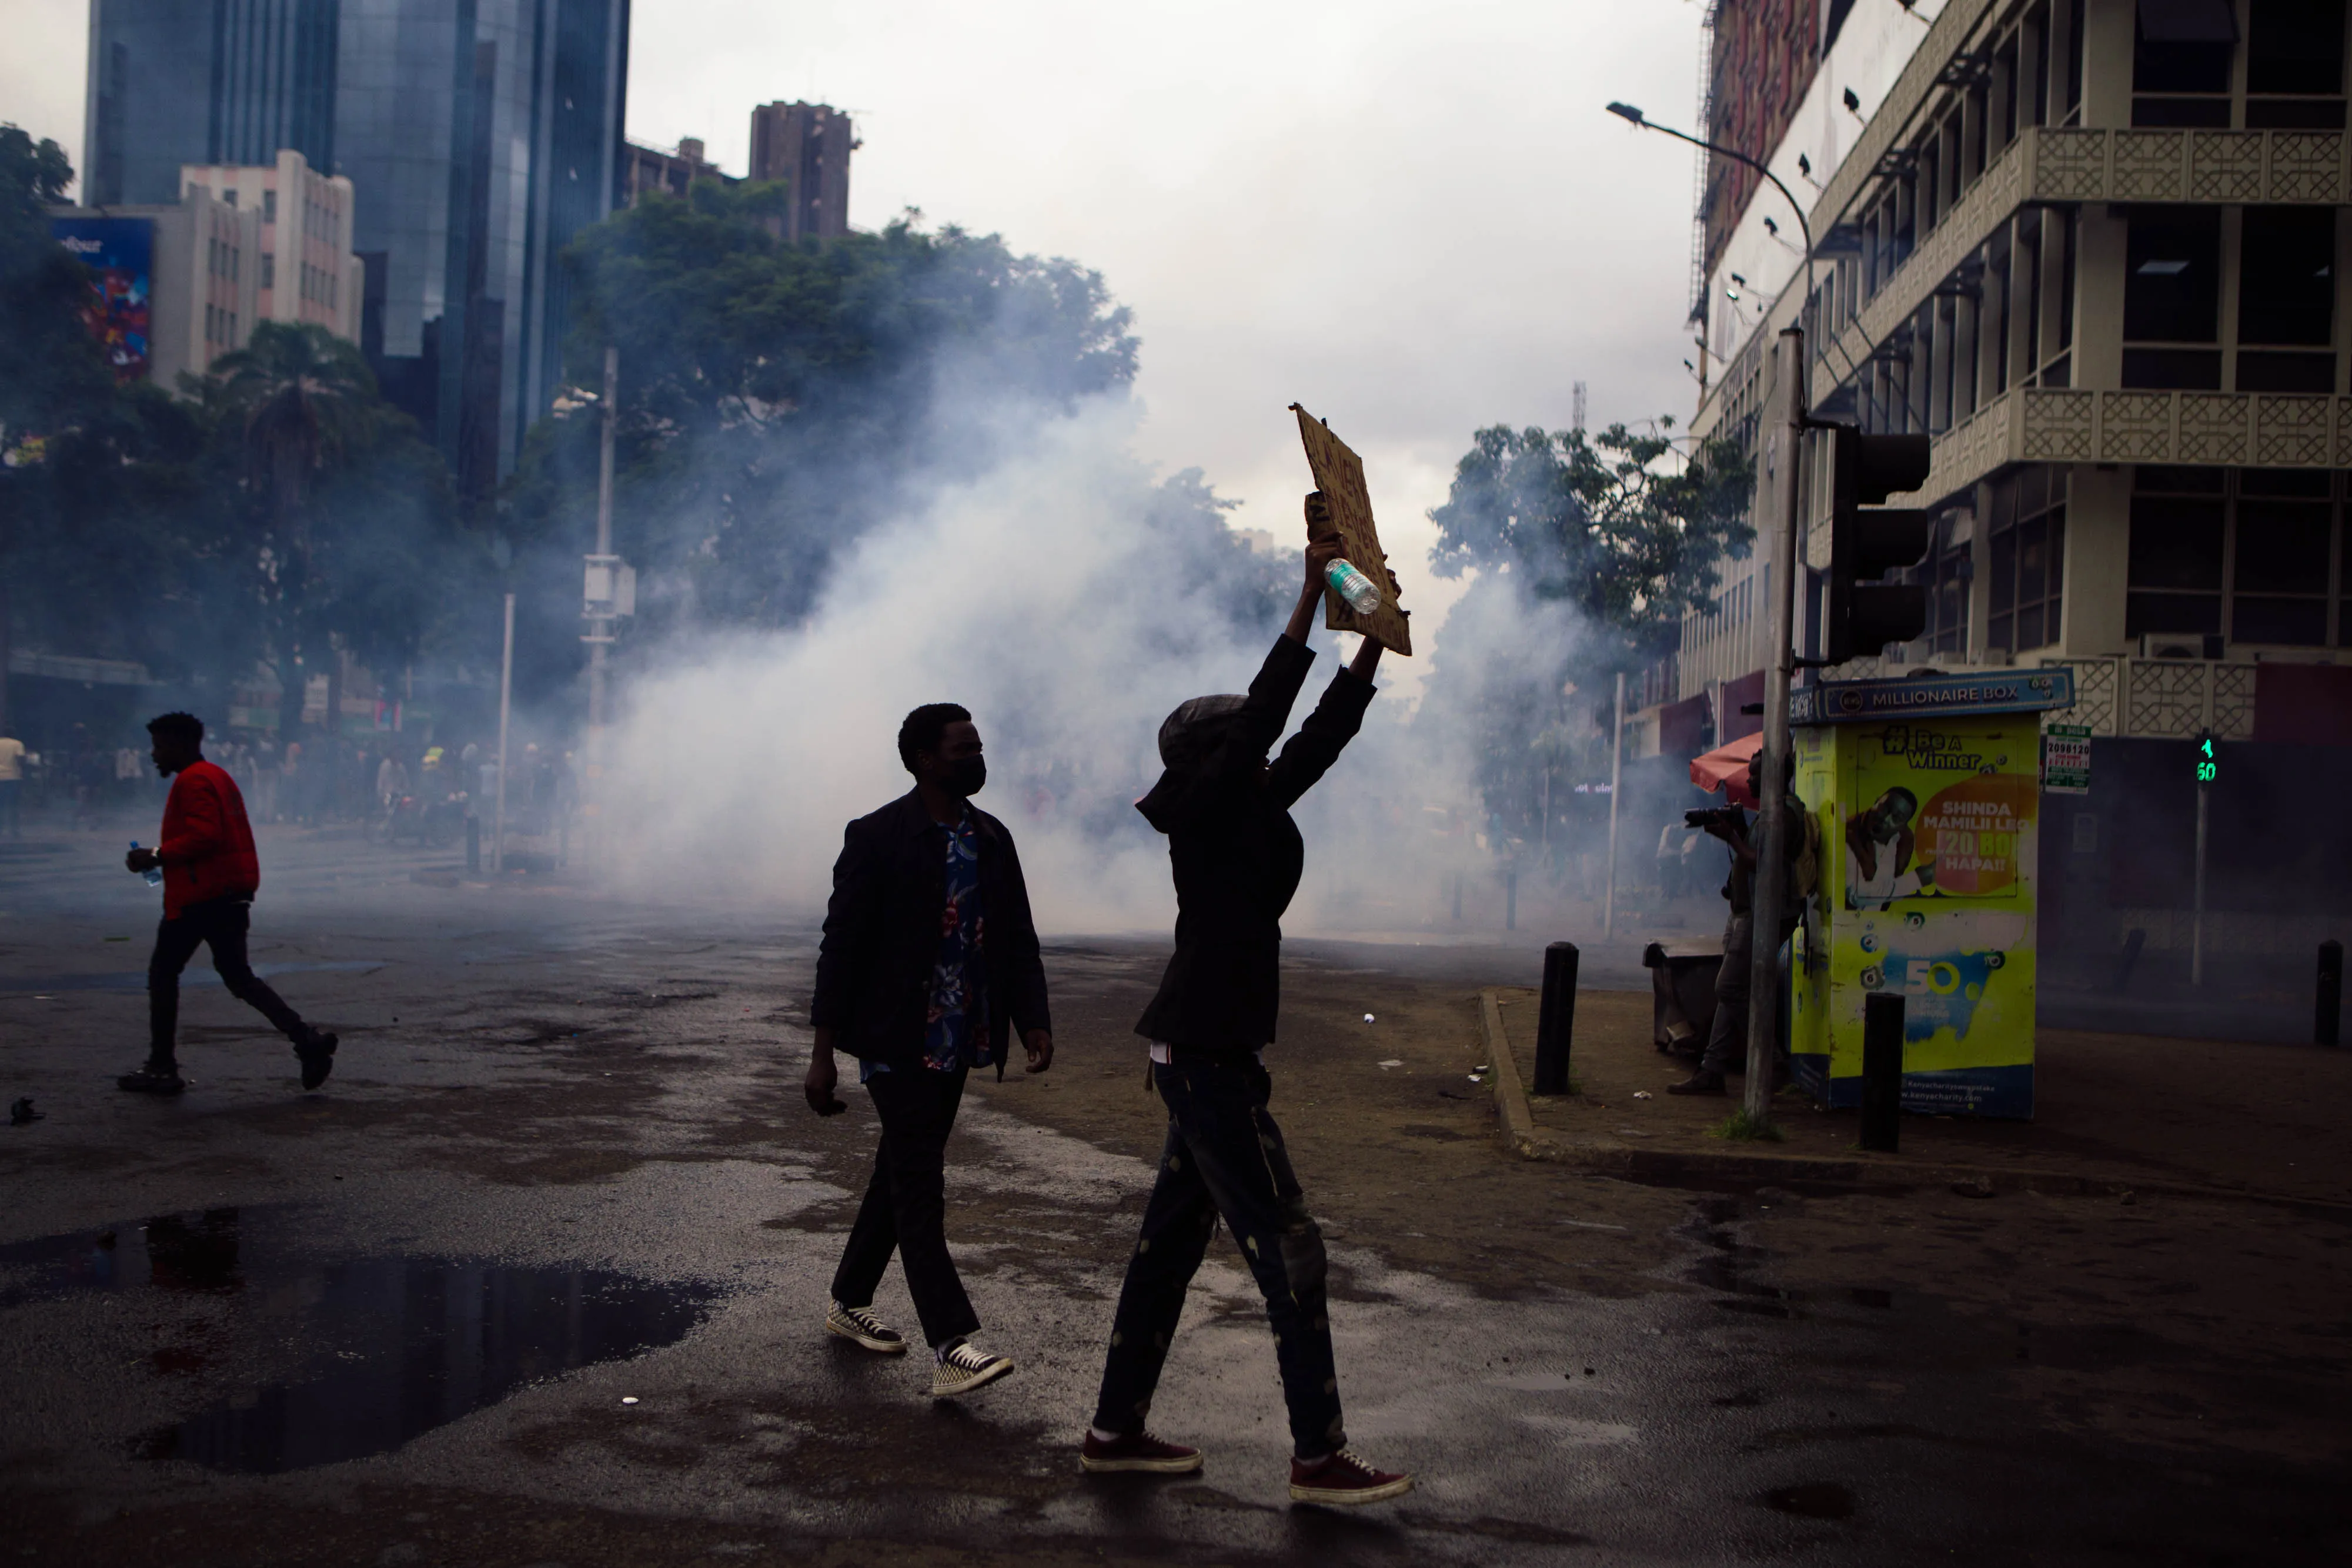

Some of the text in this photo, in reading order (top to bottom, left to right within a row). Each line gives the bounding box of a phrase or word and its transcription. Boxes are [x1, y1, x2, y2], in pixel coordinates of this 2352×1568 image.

[1873, 687, 1979, 707] MILLIONAIRE
[1983, 686, 2018, 701] BOX
[2048, 743, 2090, 755] 2098120
[1907, 750, 1981, 770] Winner
[1942, 801, 2012, 816] SHINDA
[1995, 818, 2030, 831] LEO
[1945, 831, 2017, 857] 20 BO
